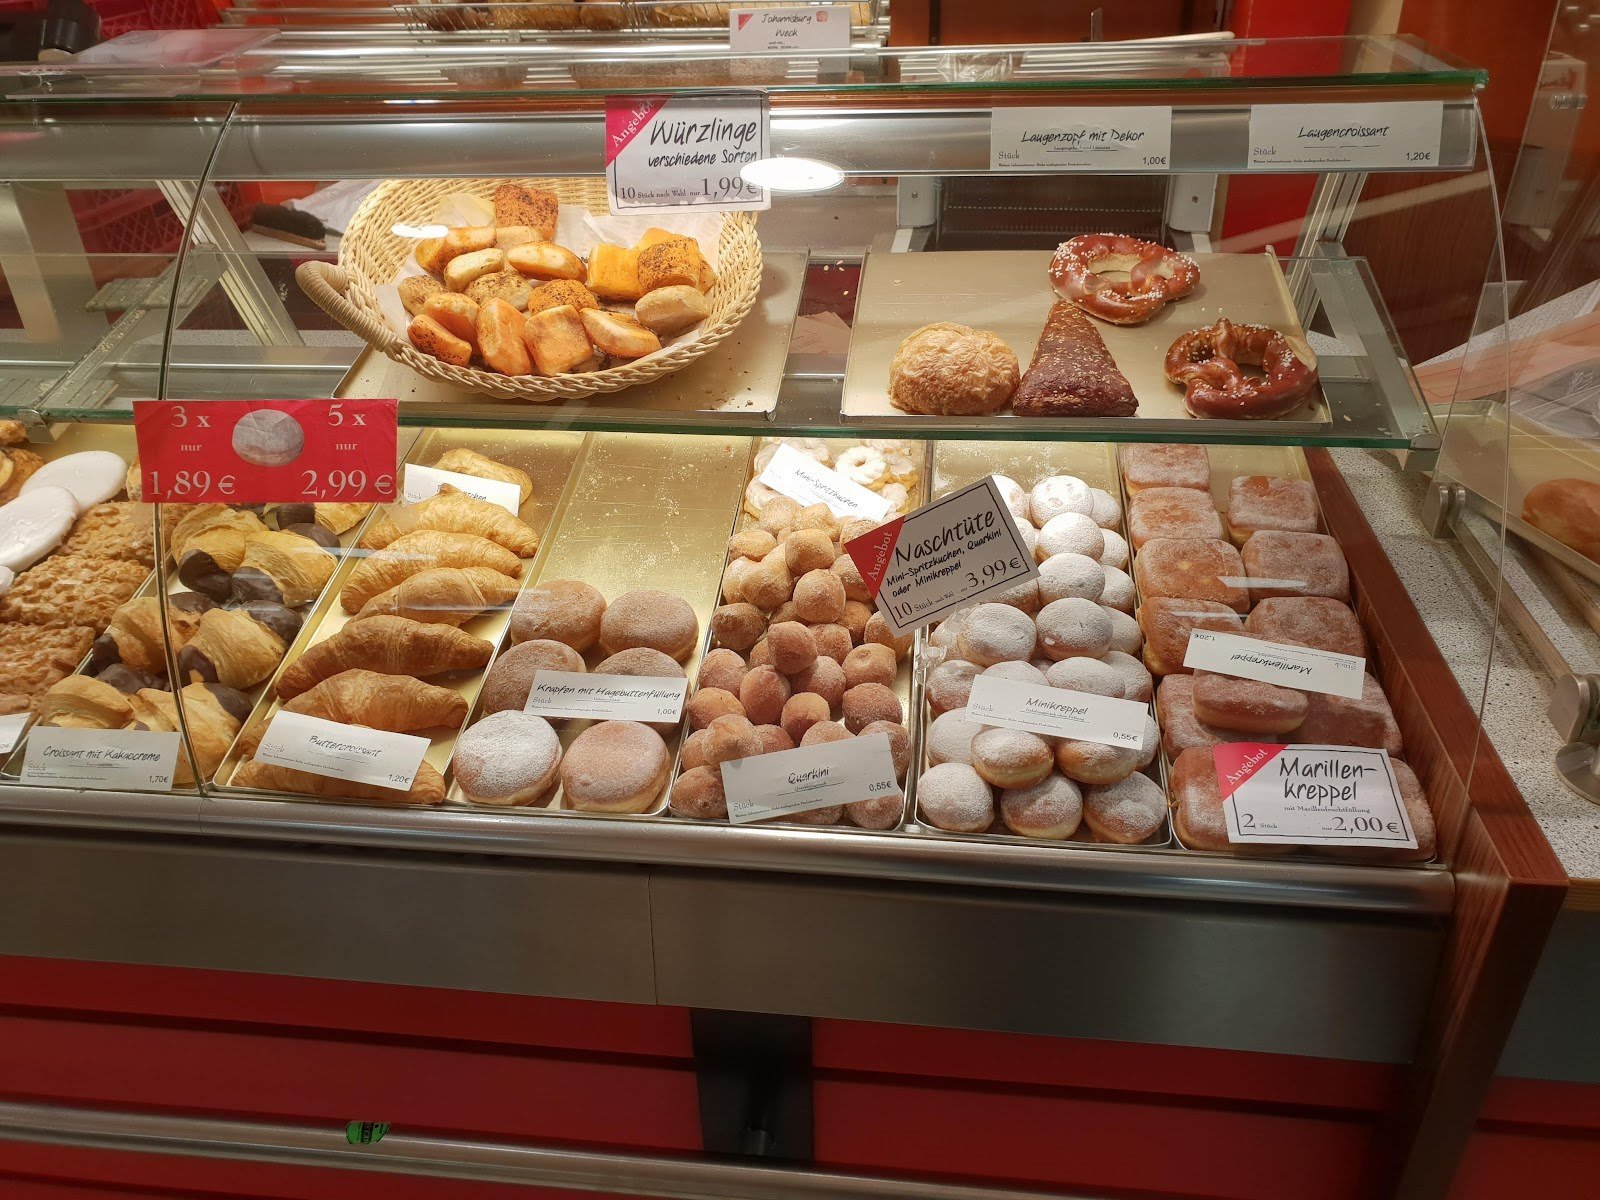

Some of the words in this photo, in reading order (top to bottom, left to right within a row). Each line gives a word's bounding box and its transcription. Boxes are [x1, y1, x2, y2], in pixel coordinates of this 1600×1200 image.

[761, 13, 812, 24] Johannisburg
[775, 28, 798, 37] Weck
[611, 100, 655, 148] Angebot
[650, 116, 757, 150] Würzlinge
[1021, 129, 1086, 146] Laugenzopf
[1088, 131, 1107, 142] mit
[1110, 128, 1145, 142] Dekor
[1298, 126, 1391, 141] Laugencroissant
[648, 152, 716, 168] verschiedene
[721, 149, 757, 163] Sorten
[998, 150, 1020, 160] Stück
[1253, 145, 1277, 156] Stück
[1406, 152, 1431, 162] 1,20€
[1142, 156, 1167, 166] 1,00€
[620, 187, 636, 200] 10
[637, 190, 655, 199] Stück
[171, 405, 188, 428] 3
[197, 414, 211, 428] x
[327, 403, 344, 427] 5
[352, 413, 367, 427] x
[180, 443, 202, 452] nur
[335, 442, 358, 450] nur
[896, 510, 995, 567] Naschtüte
[867, 531, 893, 582] Angebot
[887, 548, 965, 587] Mini-Spritzkuchen,
[967, 528, 1002, 550] Quarkini
[892, 583, 912, 598] oder
[915, 561, 962, 588] Minikreppel
[893, 601, 913, 620] 10
[1230, 653, 1313, 675] Marillenkreppel
[532, 696, 552, 704] Stück
[536, 683, 576, 695] Krapfen
[577, 687, 593, 695] mit
[596, 687, 681, 701] Hagebuttenfüllung
[972, 703, 994, 712] Stück
[1025, 697, 1089, 715] Minikreppel
[1113, 731, 1138, 742] 0,55€
[43, 745, 85, 758] Croissant
[86, 750, 102, 759] mit
[1225, 748, 1269, 786] Angebot
[1279, 757, 1378, 779] Marillen-
[148, 775, 169, 784] 1,70€
[388, 773, 411, 784] 1,20€
[788, 766, 830, 785] Quarkini
[868, 780, 893, 792] 0,55€
[1283, 779, 1357, 807] kreppel
[733, 799, 754, 812] Stück
[1241, 813, 1257, 829] 2
